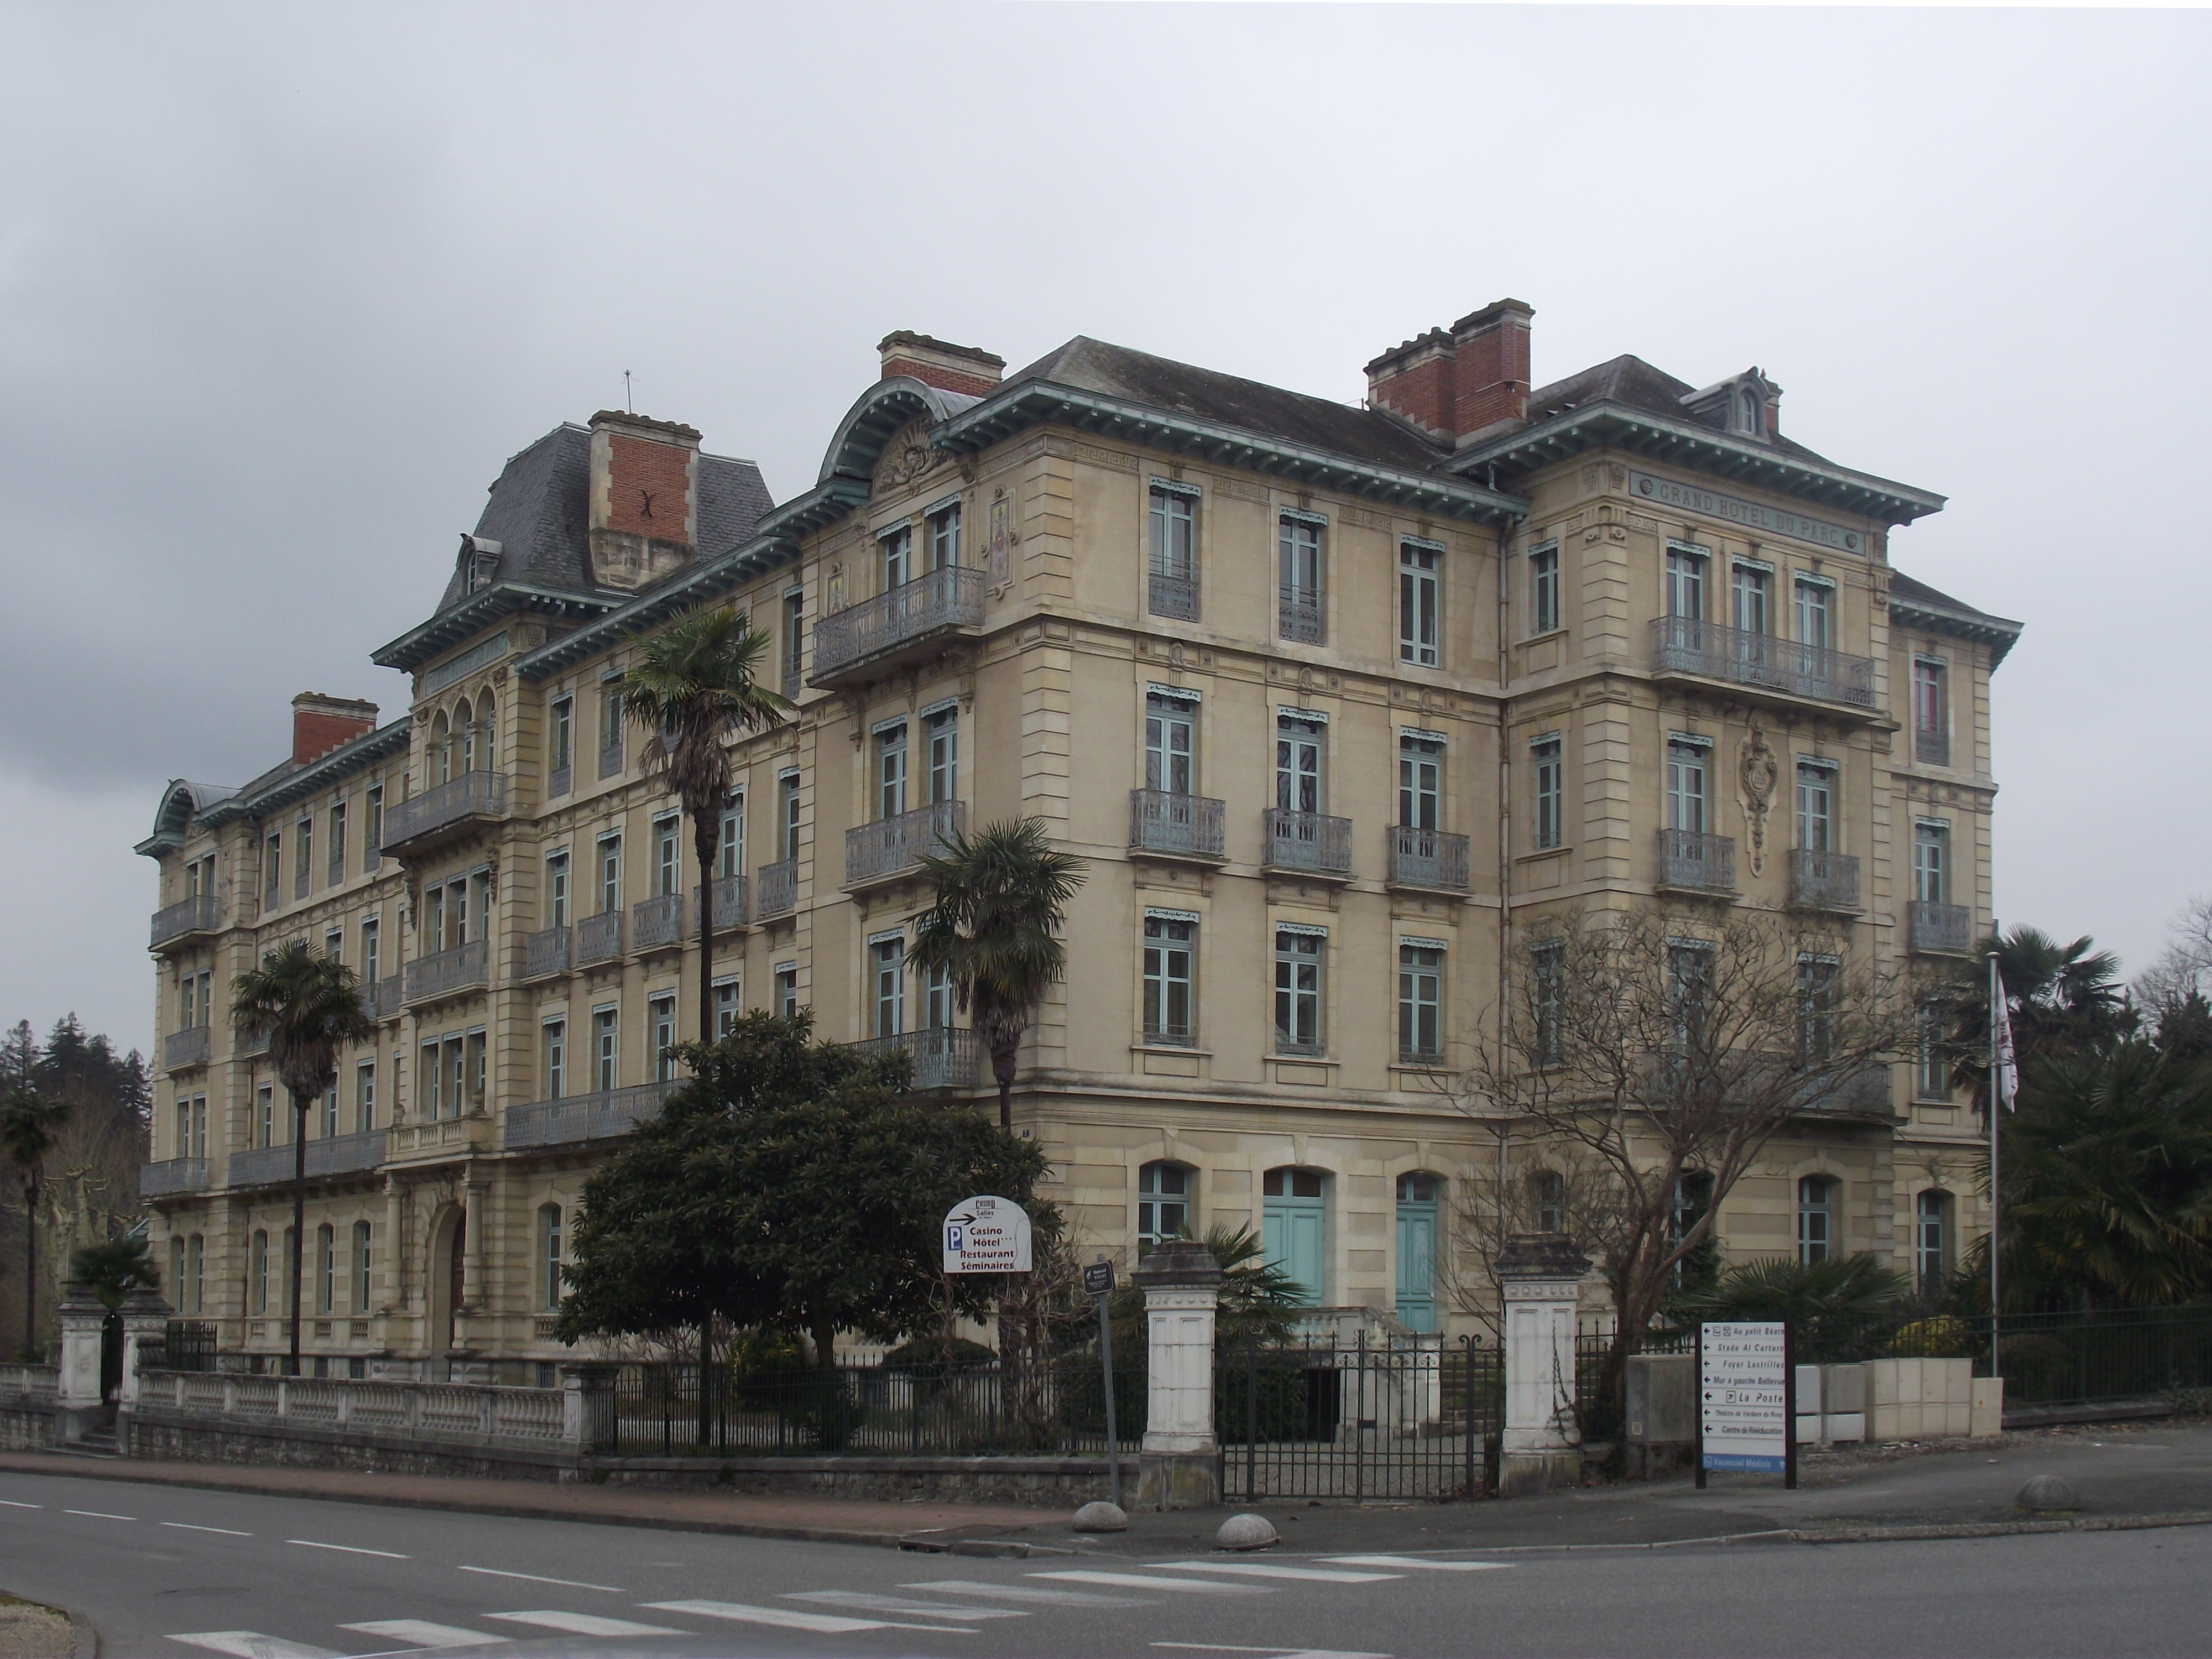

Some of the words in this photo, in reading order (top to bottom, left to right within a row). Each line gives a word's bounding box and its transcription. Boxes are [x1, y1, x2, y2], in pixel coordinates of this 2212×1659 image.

[1660, 484, 1712, 510] GRAND
[1720, 500, 1768, 525] HOTEL
[1777, 515, 1794, 533] DU
[1801, 521, 1838, 544] PARC
[970, 1227, 1003, 1235] Casino
[950, 1227, 961, 1249] P
[960, 1250, 1014, 1259] Restaurant
[961, 1261, 1014, 1270] Séminaires
[1745, 1327, 1761, 1336] petit
[1717, 1343, 1739, 1352] Stade
[1755, 1344, 1784, 1352] Cartero
[1723, 1360, 1743, 1369] Foyer
[1734, 1377, 1756, 1386] gauche
[1758, 1377, 1785, 1385] Bellevue
[1739, 1392, 1749, 1402] La
[1756, 1393, 1783, 1402] Poste
